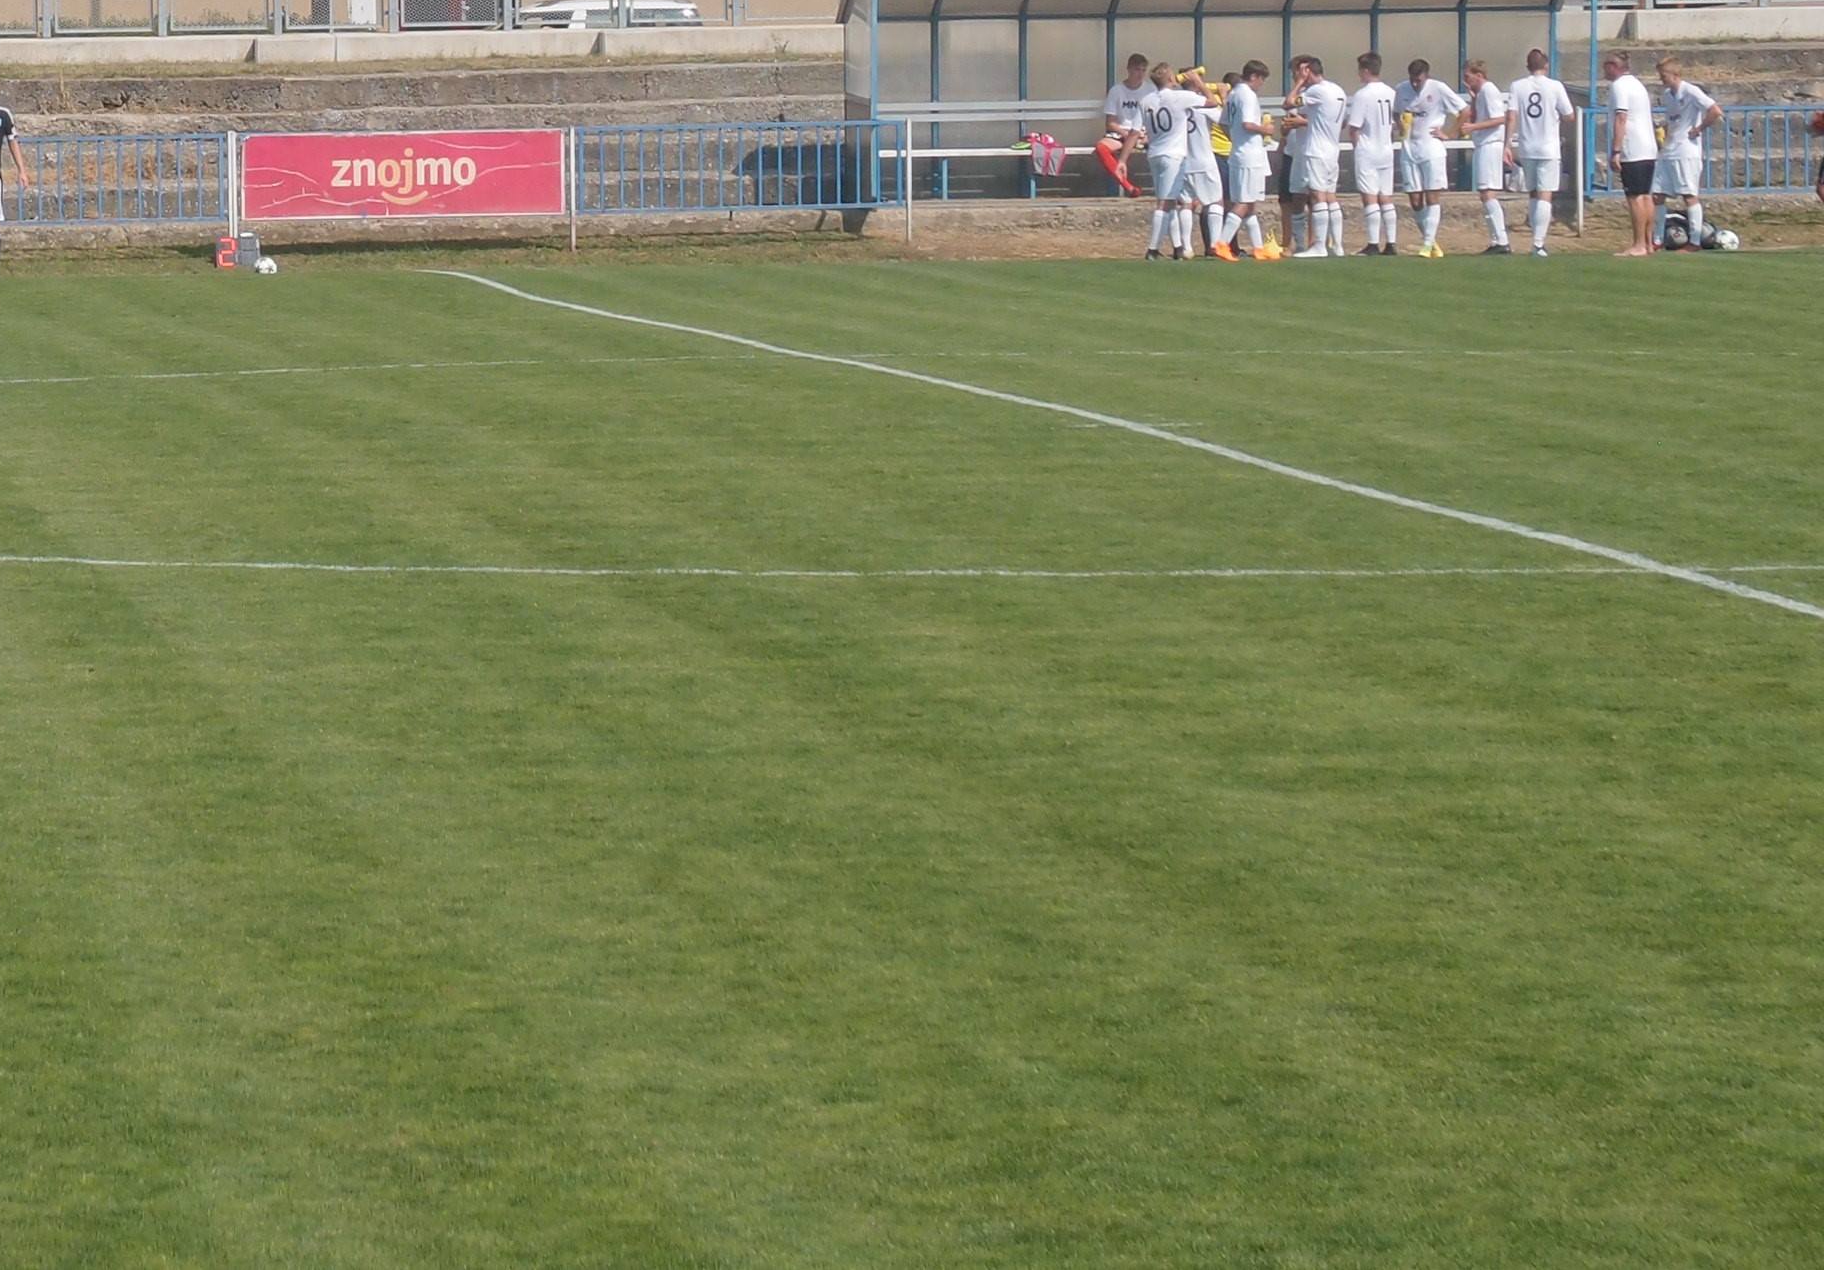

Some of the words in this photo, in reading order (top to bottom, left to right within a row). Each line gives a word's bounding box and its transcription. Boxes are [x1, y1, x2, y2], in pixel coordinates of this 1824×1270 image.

[1336, 97, 1345, 124] 7
[1377, 99, 1392, 126] 11
[1526, 91, 1543, 119] 8
[1145, 106, 1173, 135] 10
[331, 147, 477, 195] znojmo
[217, 237, 237, 267] 2
